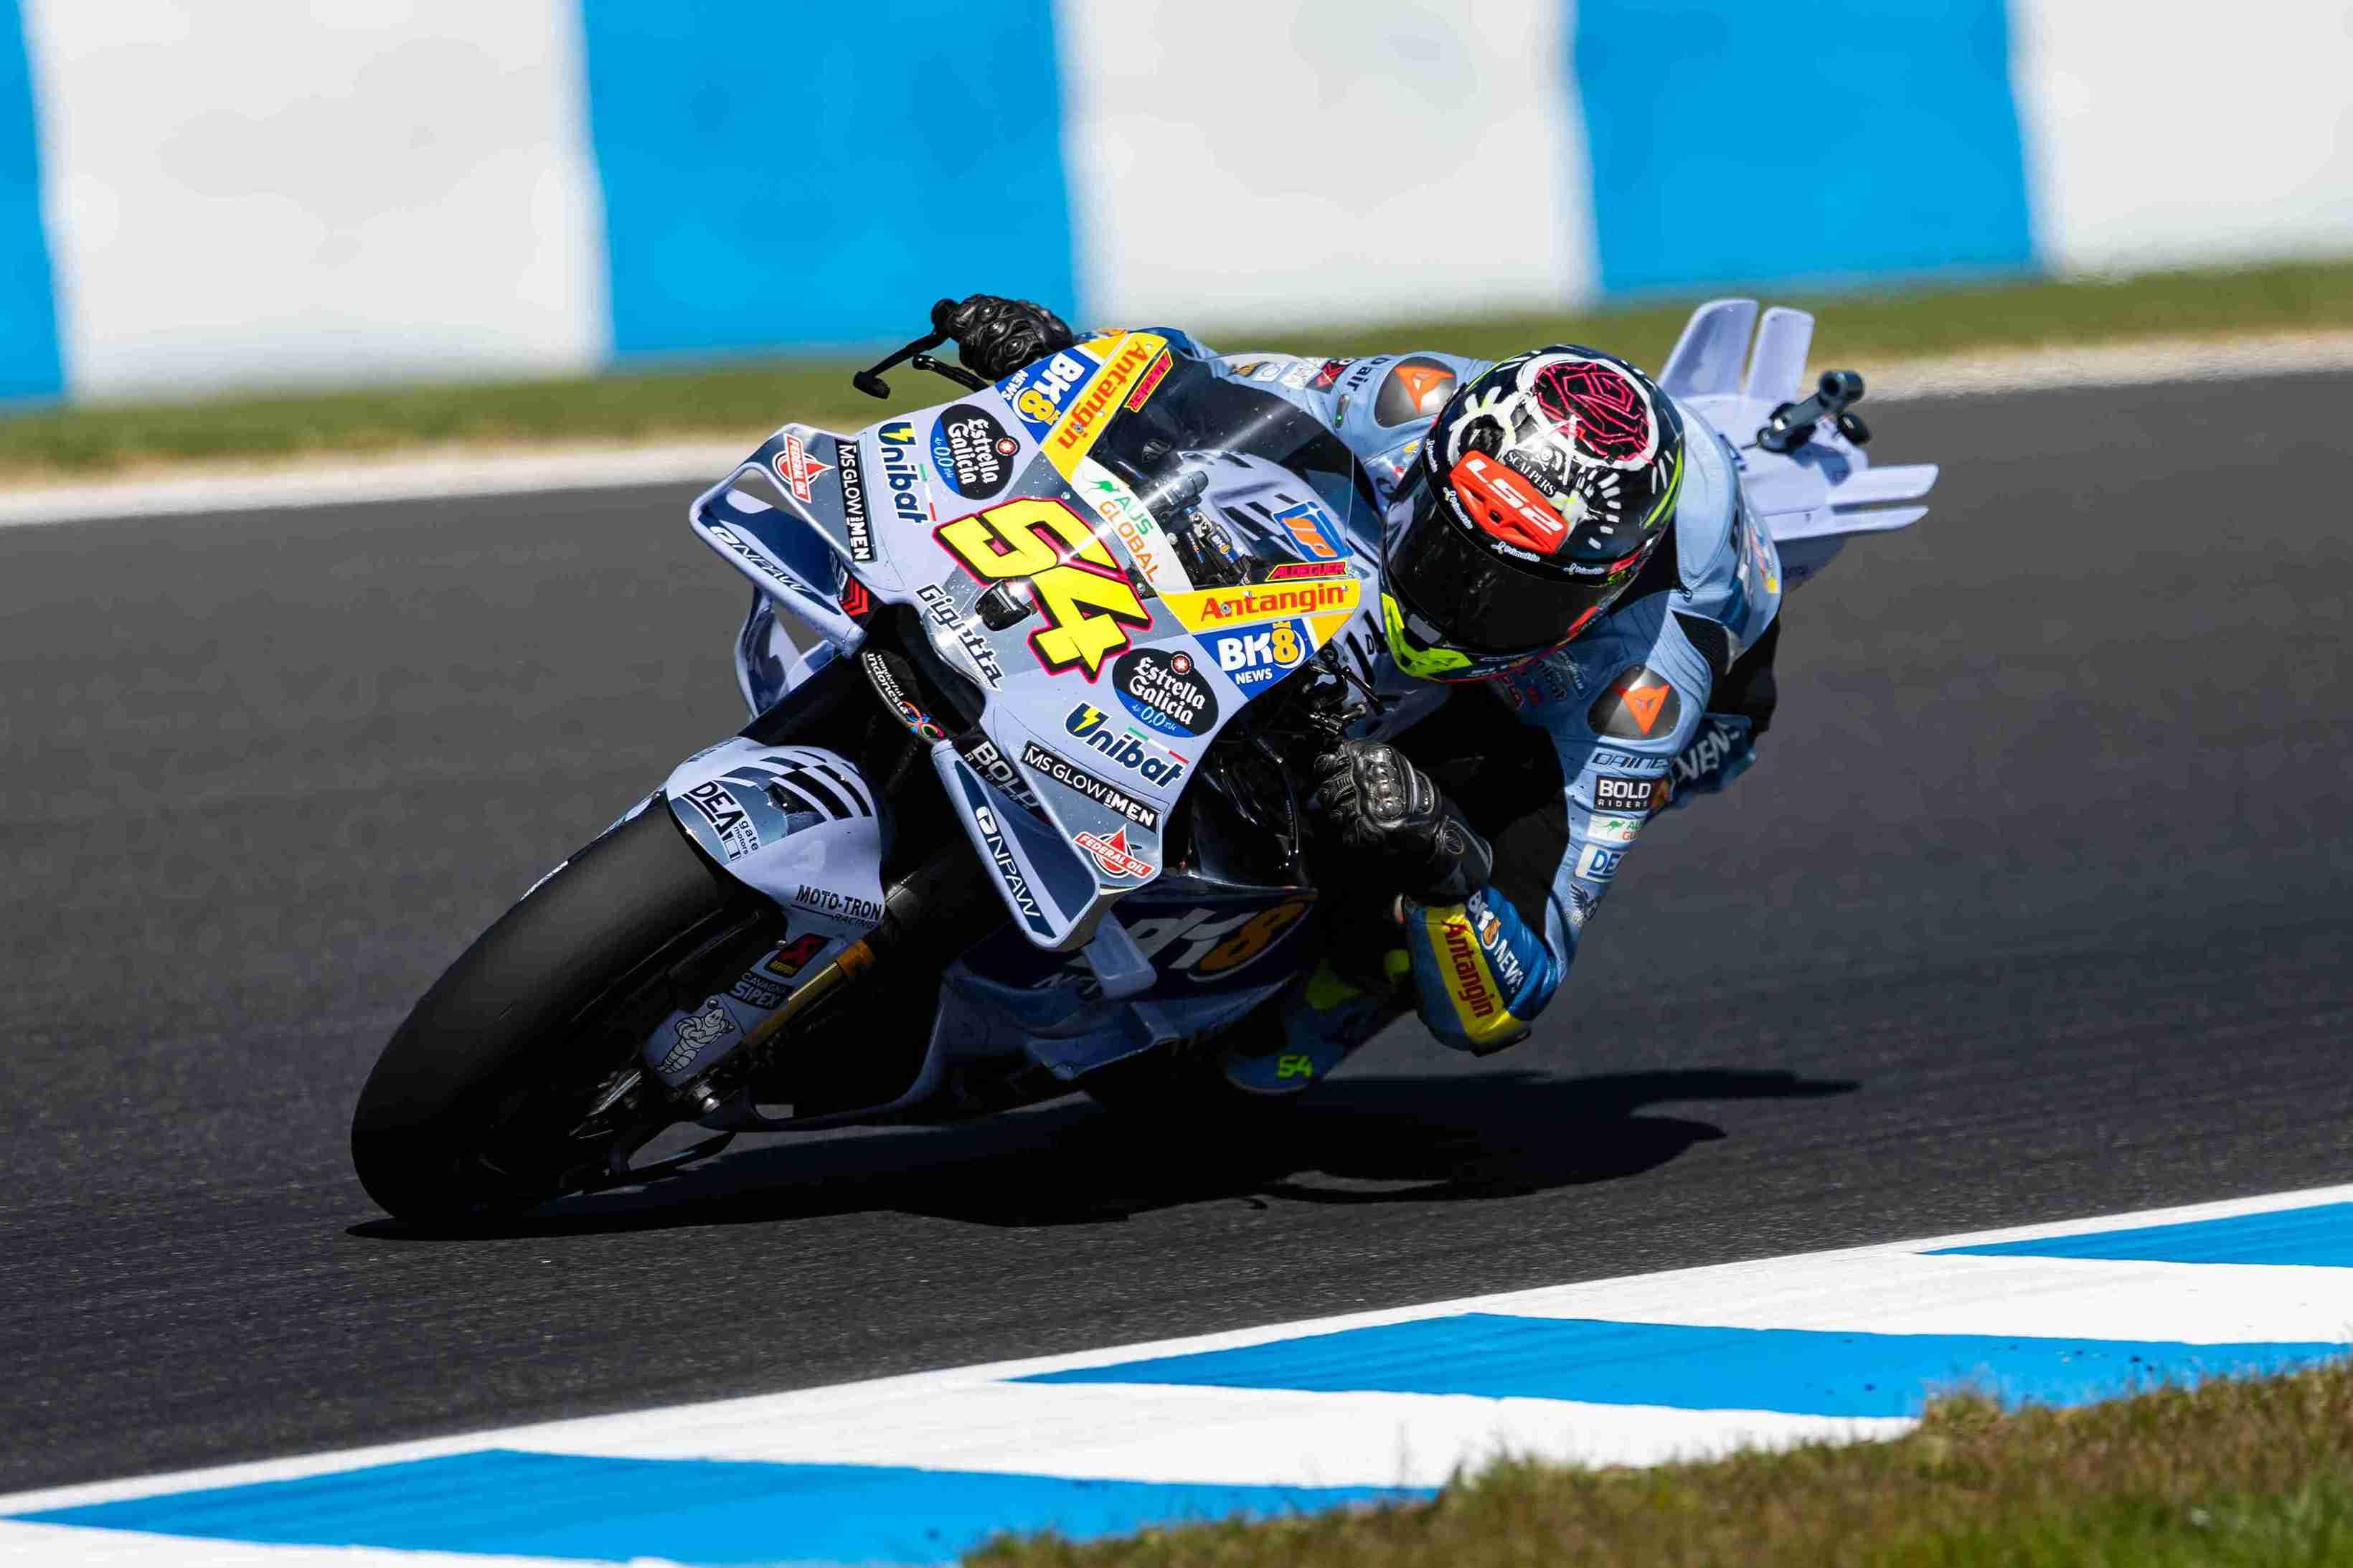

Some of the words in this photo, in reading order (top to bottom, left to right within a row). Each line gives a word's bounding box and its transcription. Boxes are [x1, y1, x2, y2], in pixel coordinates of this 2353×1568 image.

[1001, 369, 1029, 401] NEWS
[1018, 353, 1085, 421] BK8
[1057, 341, 1148, 449] Antangin
[839, 443, 857, 467] MS
[879, 422, 929, 523] Unibat
[934, 447, 955, 467] 0,0
[948, 422, 977, 485] Galicia
[967, 418, 1000, 483] Estrella
[1506, 450, 1556, 495] SCALPERS
[841, 468, 863, 515] GLOW
[1465, 458, 1564, 535] LS2
[850, 521, 871, 560] MEN
[1099, 501, 1163, 582] GLOBAL
[935, 497, 1151, 680] 54
[1201, 582, 1344, 622] Antangin
[1218, 627, 1297, 672] BK8
[1133, 656, 1206, 710] Estrella
[1235, 667, 1273, 684] NEWS
[1129, 675, 1194, 725] Galicia
[1141, 706, 1166, 727] 0,0
[1065, 702, 1183, 788] Unibat
[971, 740, 1041, 808] BOLD
[1024, 745, 1052, 773] MS
[1052, 763, 1108, 800] GLOW
[1111, 791, 1155, 828] MEN
[1598, 779, 1652, 799] BOLD
[733, 826, 750, 856] motors
[739, 820, 759, 851] gate
[1079, 834, 1126, 865] FEDERAL
[1127, 860, 1147, 875] OIL
[796, 884, 883, 920] MOTO-TRON
[1440, 918, 1495, 1019] Antangin
